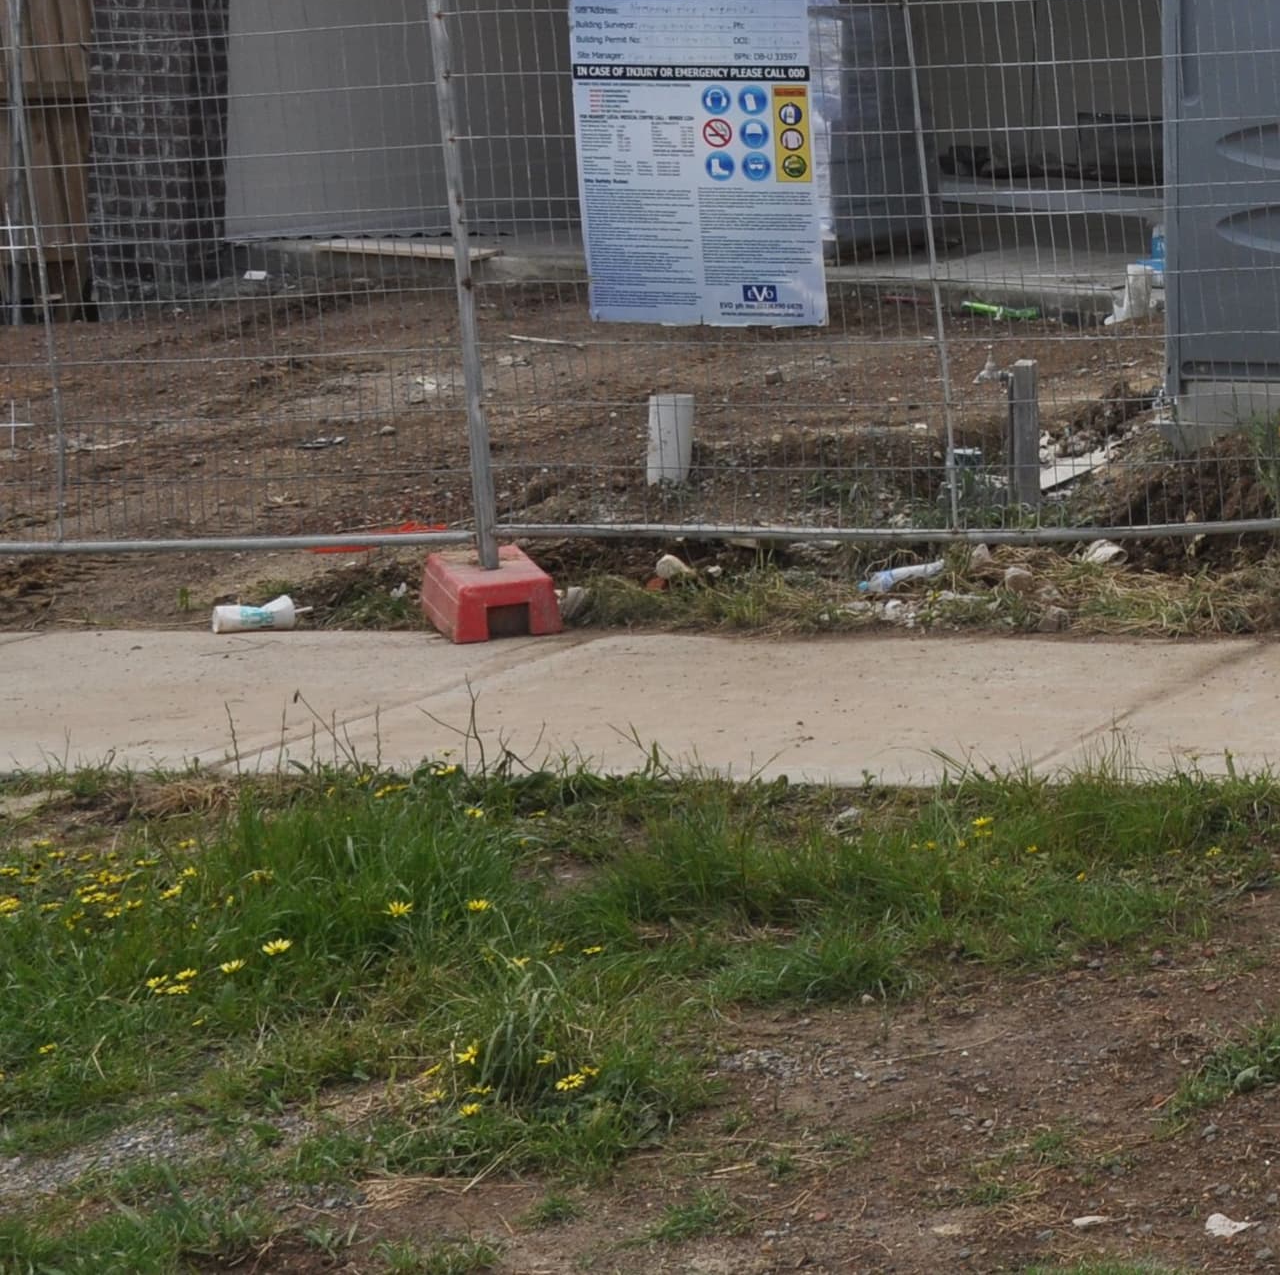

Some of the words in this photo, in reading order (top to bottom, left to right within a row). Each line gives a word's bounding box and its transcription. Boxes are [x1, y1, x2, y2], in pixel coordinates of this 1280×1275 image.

[577, 66, 587, 76] IN
[589, 66, 610, 76] CASE
[612, 66, 624, 76] OF
[626, 67, 658, 77] INJURY
[660, 67, 673, 77] OR
[675, 67, 728, 78] EMERGENCY
[730, 68, 763, 78] PLEASE
[765, 68, 786, 78] CALL
[788, 68, 805, 78] 000
